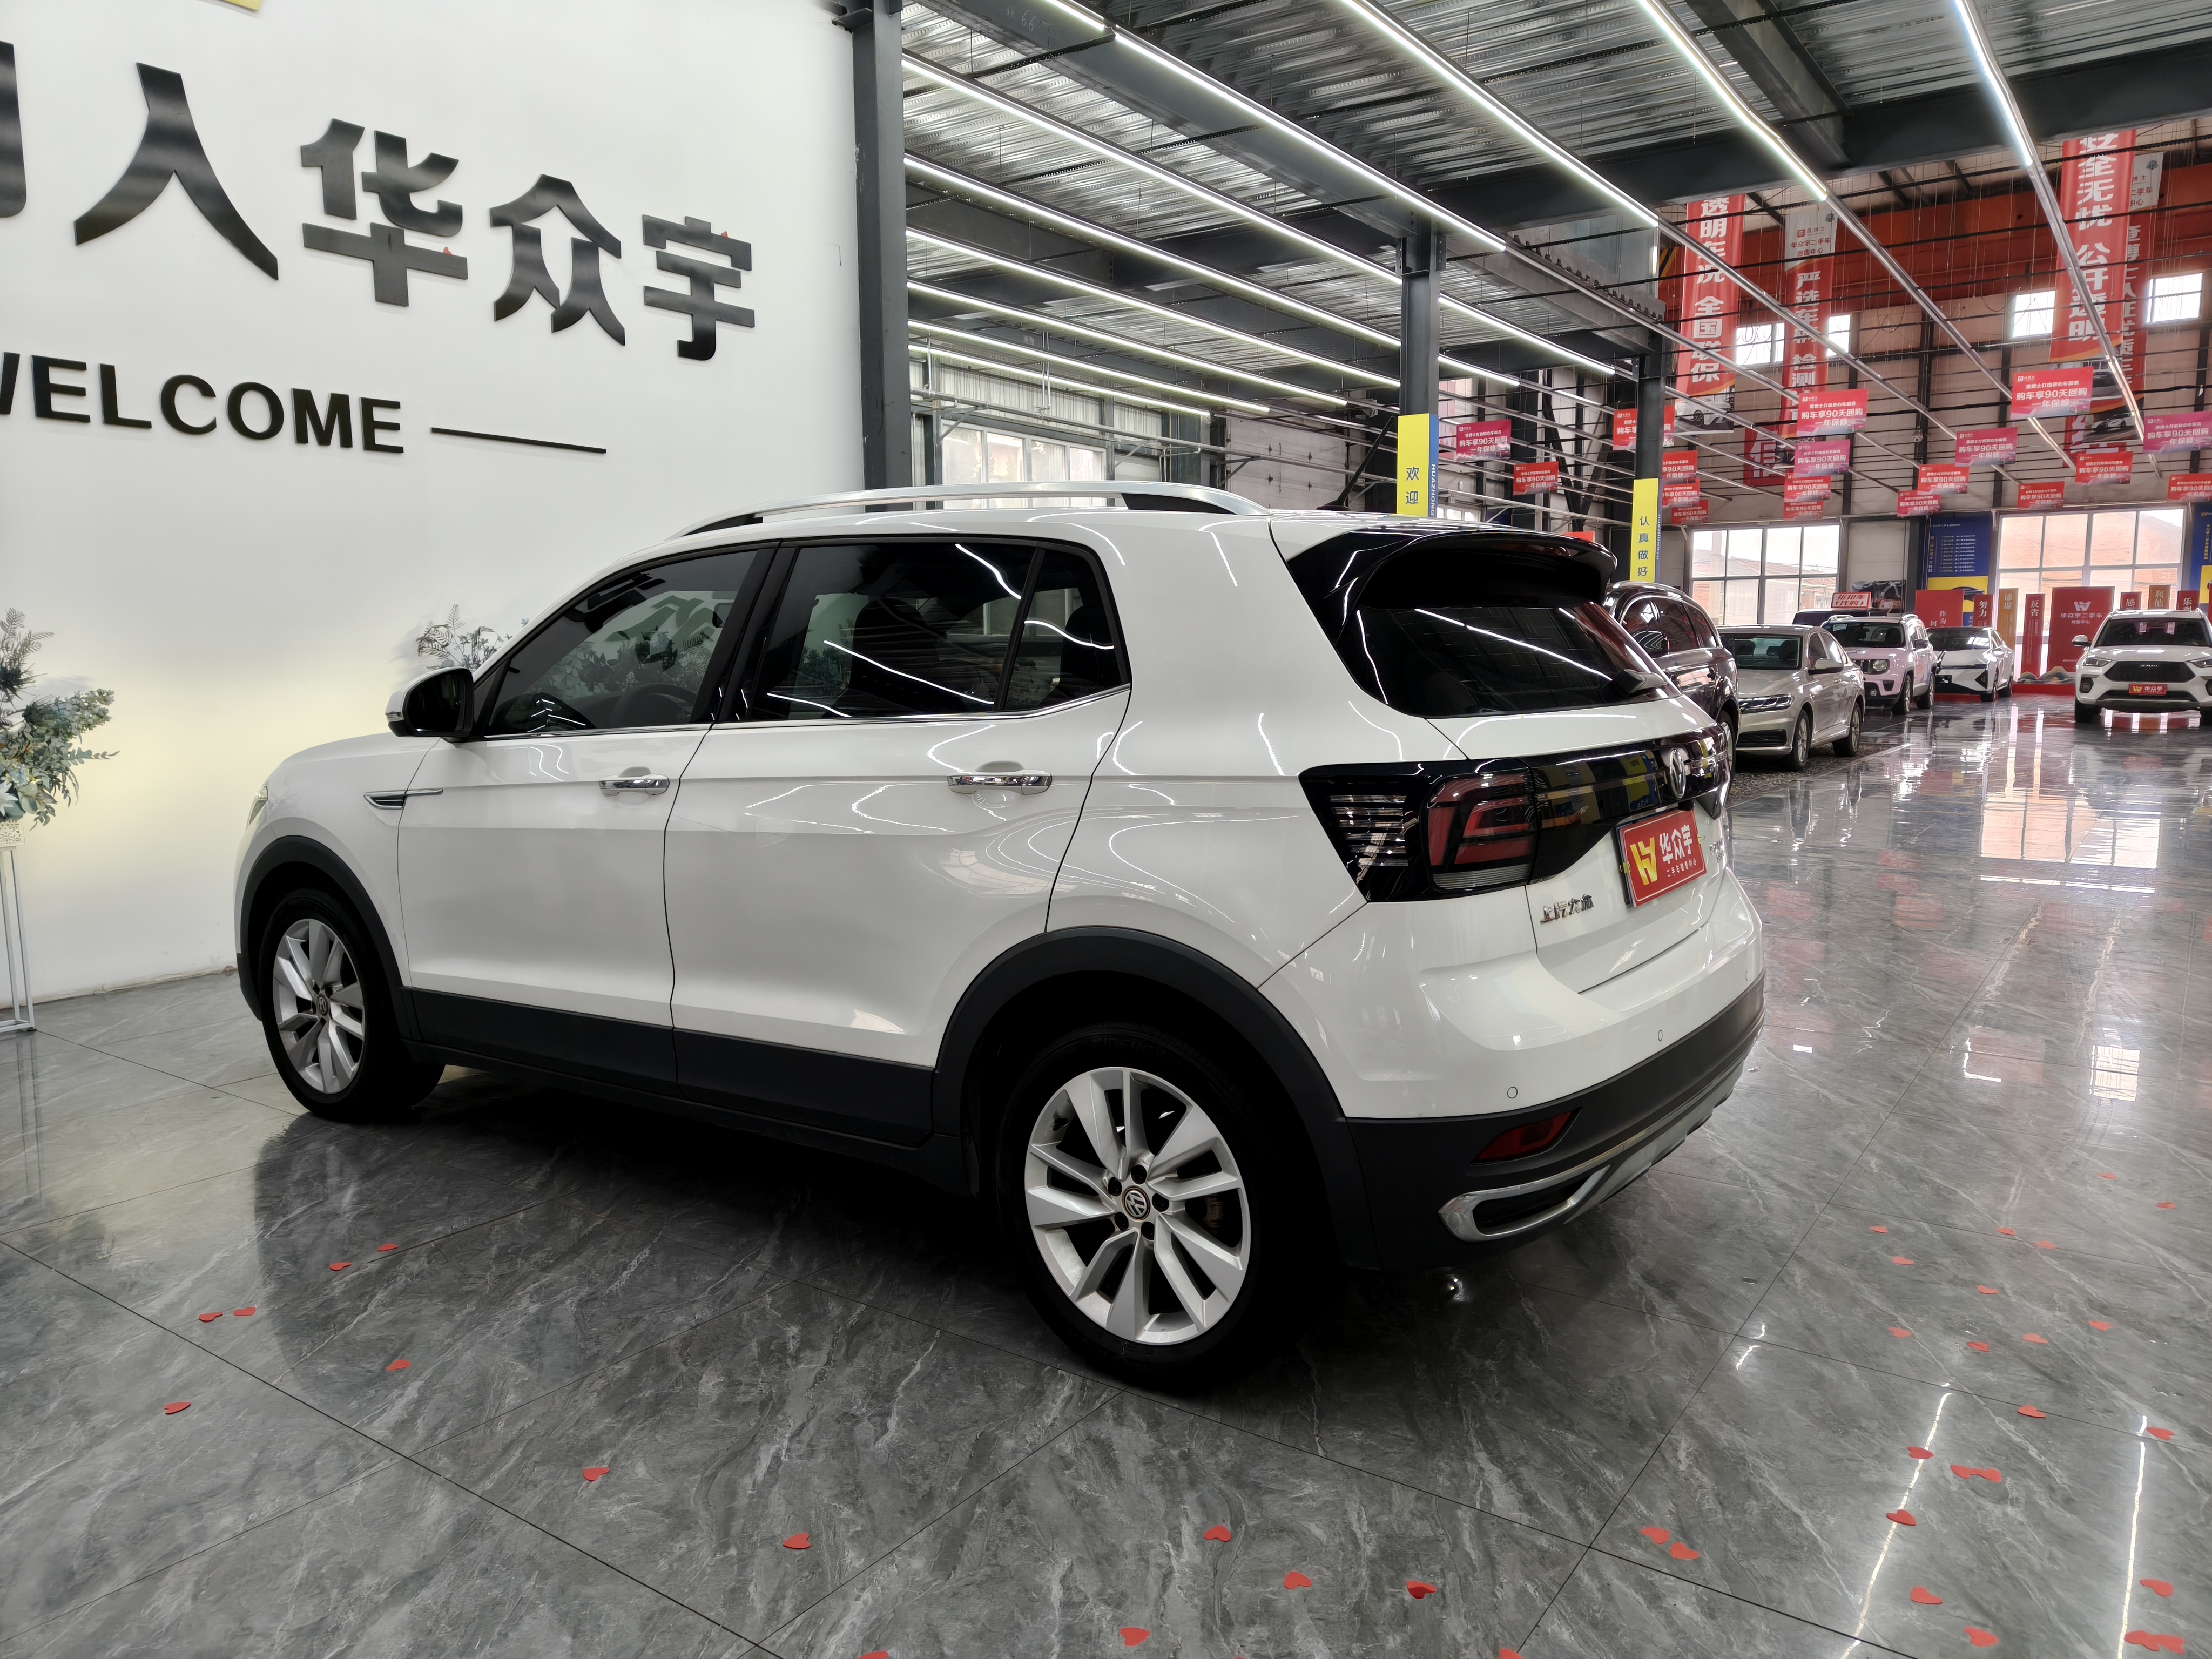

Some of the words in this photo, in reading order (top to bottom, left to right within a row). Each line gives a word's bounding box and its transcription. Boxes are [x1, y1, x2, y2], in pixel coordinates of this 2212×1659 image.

[2016, 388, 2087, 400] 购车享90天回购
[0, 351, 403, 453] ELCOME
[2032, 399, 2069, 408] 一年保修
[1802, 408, 1863, 419] 购车享90天回购
[1815, 418, 1847, 427] 一年保修
[2147, 428, 2209, 439] 购车享90天回购
[1459, 436, 1508, 447] 购车享90天回购
[2161, 437, 2194, 445] 一年保修
[1959, 443, 2013, 453] 购车享90天回购
[1798, 455, 1846, 463] 购车享90天回购
[1516, 475, 1556, 483] 购车享90天回购
[1405, 467, 1419, 505] 欢迎
[1637, 516, 1649, 576] 认真做好
[1979, 601, 1988, 617] 努力
[2031, 600, 2040, 616] 反省
[1660, 825, 1692, 864] 华众宇
